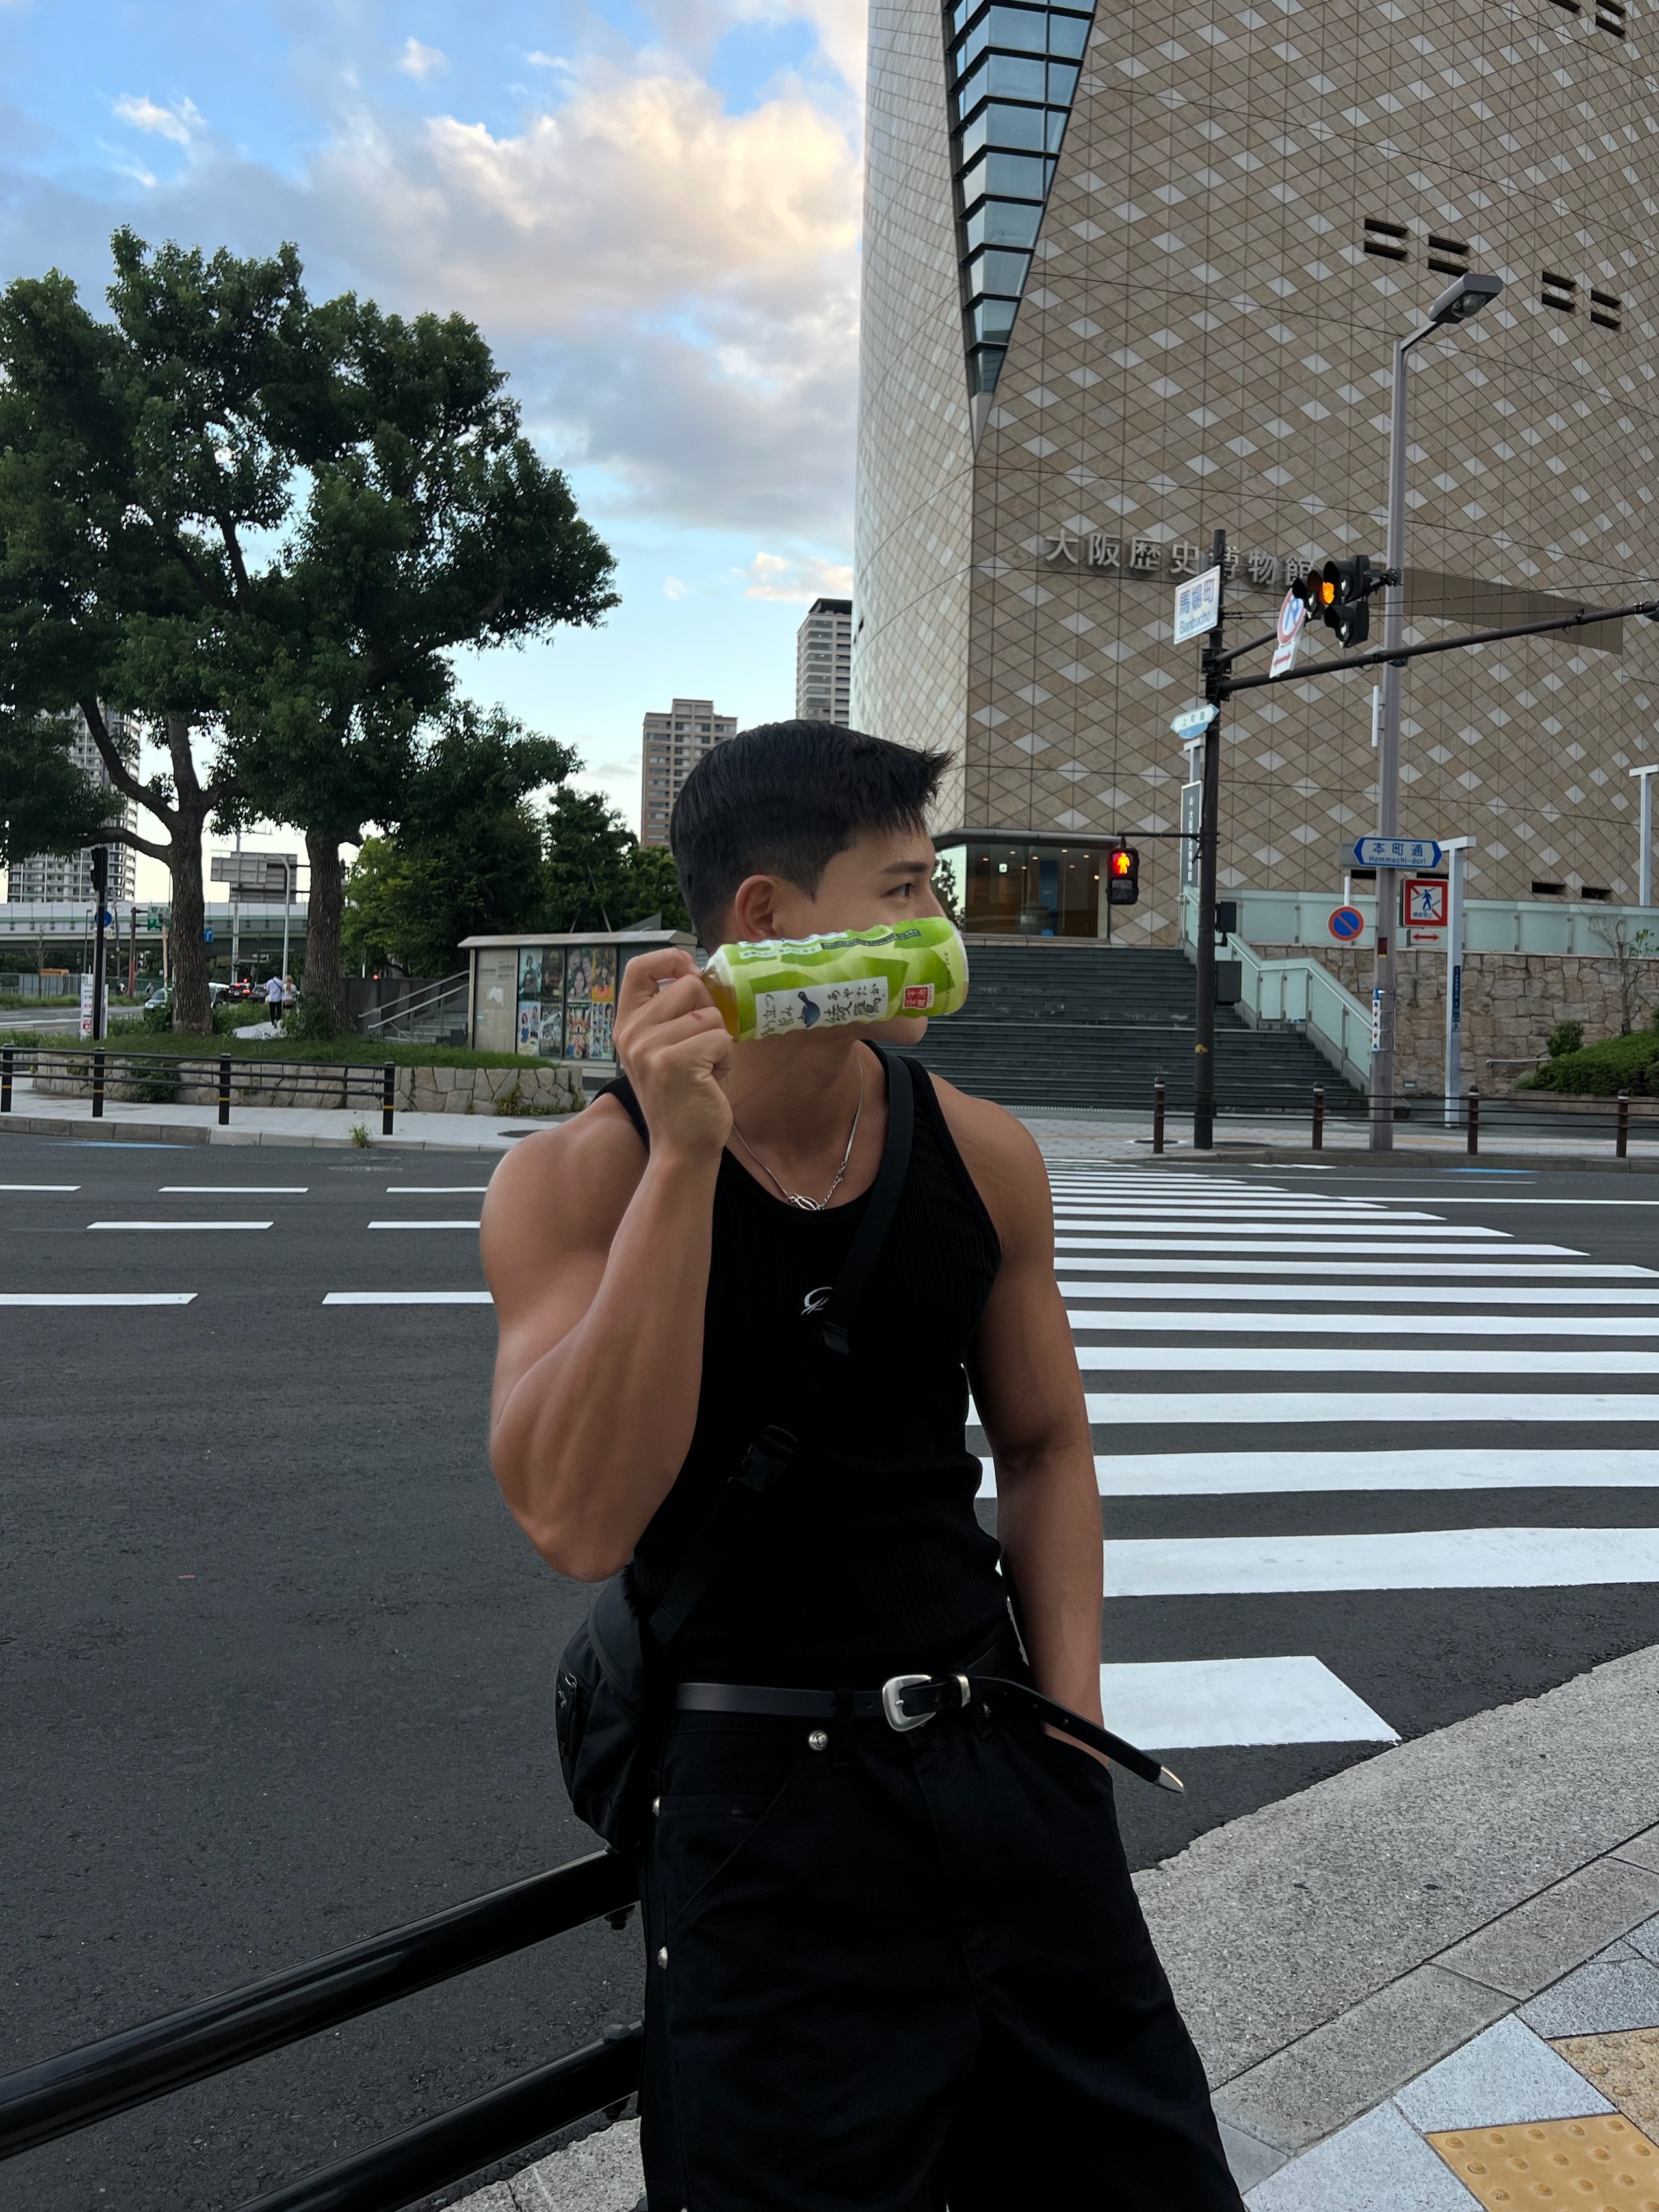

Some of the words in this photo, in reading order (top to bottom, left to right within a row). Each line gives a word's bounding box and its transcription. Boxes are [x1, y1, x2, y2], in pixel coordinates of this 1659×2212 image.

[1179, 578, 1215, 616] 馬場町
[1369, 855, 1426, 865] Hommachi-dori
[1372, 842, 1423, 857] 本町通
[827, 983, 880, 1000] あやたか
[760, 994, 777, 1037] 香り立つ
[777, 1005, 794, 1026] 旨み
[824, 997, 882, 1024] 綾鷹
